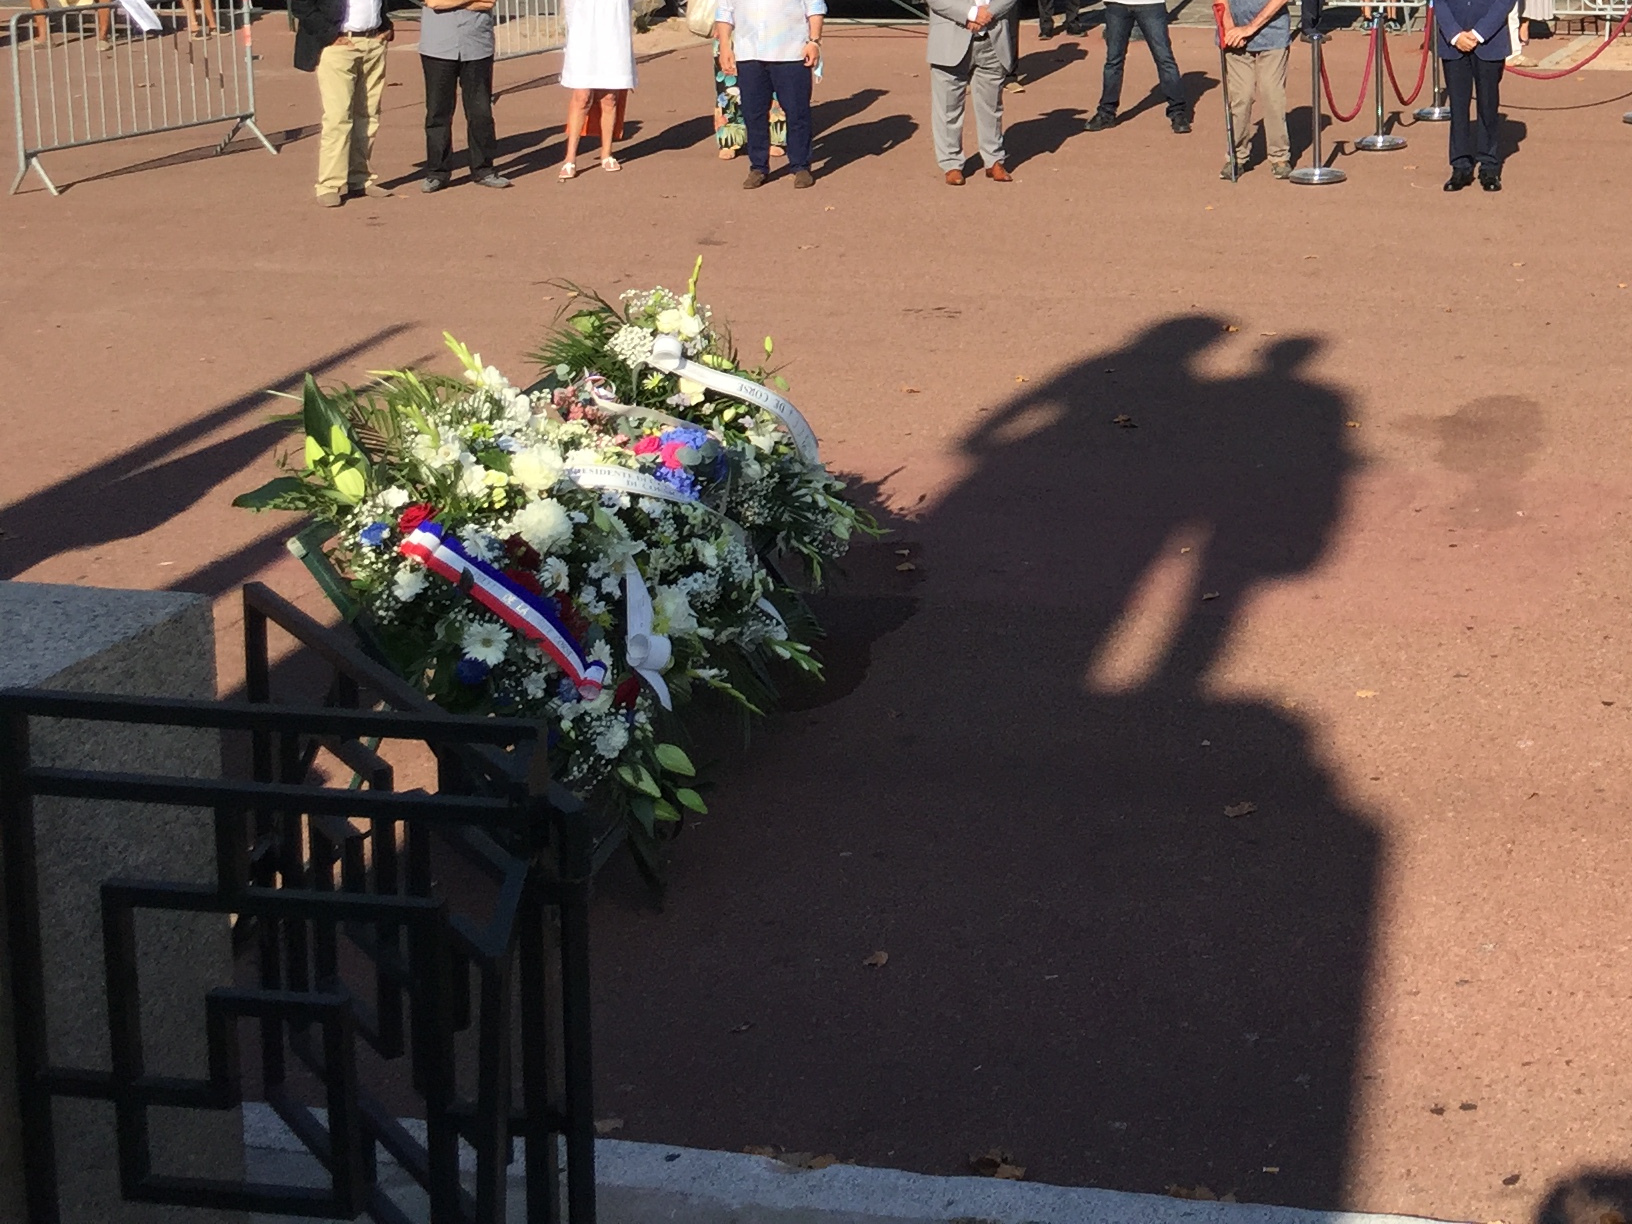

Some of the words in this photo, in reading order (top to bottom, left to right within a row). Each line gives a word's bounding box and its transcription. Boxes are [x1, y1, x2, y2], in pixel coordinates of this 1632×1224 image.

[737, 382, 769, 403] CORSE
[503, 594, 516, 605] DE
[515, 601, 529, 615] LA
